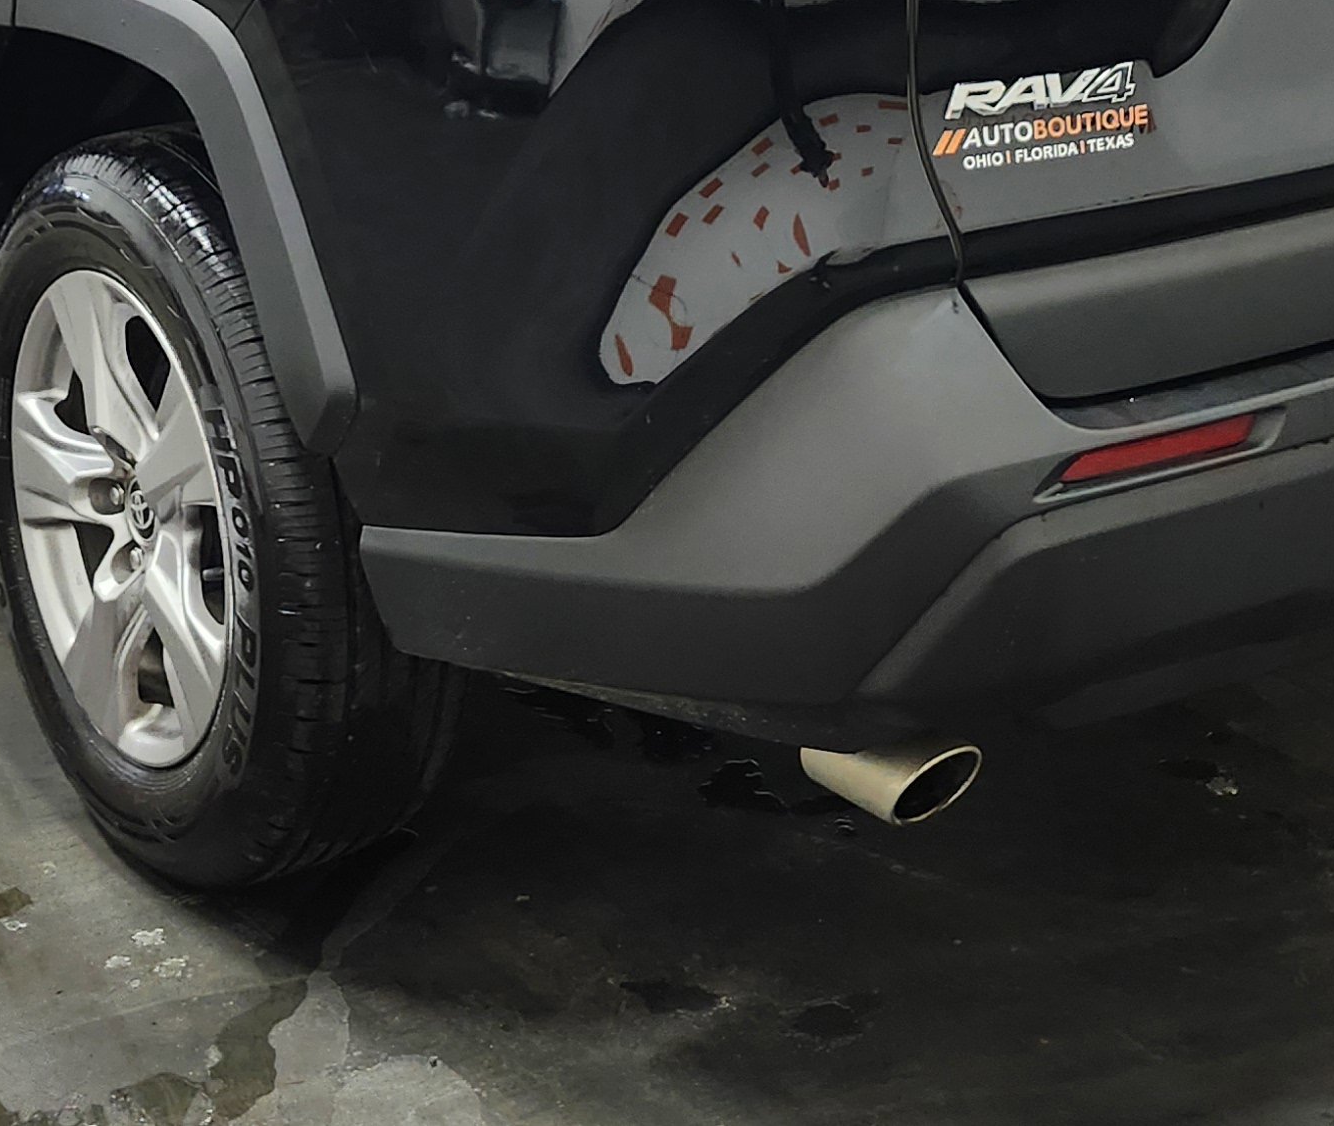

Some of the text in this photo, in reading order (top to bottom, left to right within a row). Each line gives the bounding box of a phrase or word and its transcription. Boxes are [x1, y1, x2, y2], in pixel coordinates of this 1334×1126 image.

[944, 61, 1136, 120] RAV4
[961, 104, 1149, 149] AUTOBOUTIQUE
[963, 133, 1135, 170] OHIO FLORIDA TEXAS
[222, 612, 257, 775] PLUS
